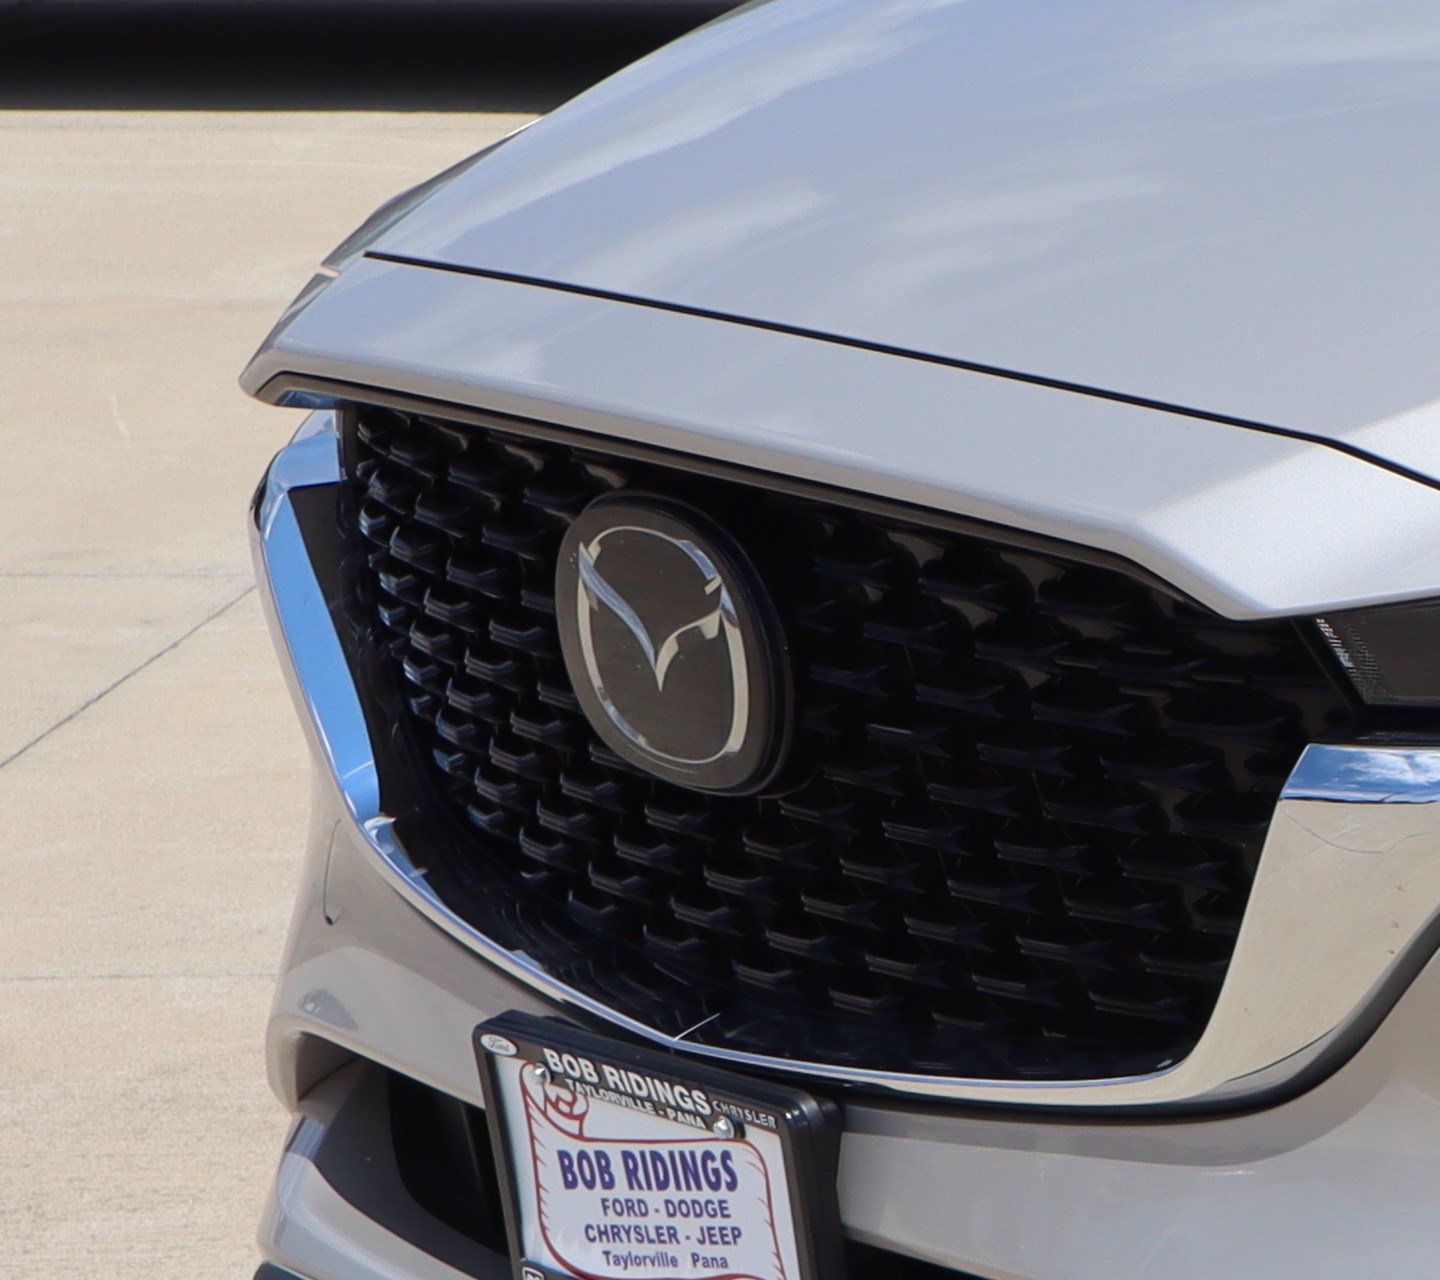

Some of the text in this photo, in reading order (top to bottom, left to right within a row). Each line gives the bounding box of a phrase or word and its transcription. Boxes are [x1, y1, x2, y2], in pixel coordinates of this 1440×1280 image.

[542, 1047, 713, 1116] BOB RIDINGS
[565, 1078, 655, 1114] TAYLORVILLE
[667, 1109, 708, 1130] PANA
[711, 1099, 777, 1129] CHRYSLER
[556, 1149, 739, 1193] BOB RIDINGS
[600, 1197, 650, 1218] FORD
[664, 1198, 732, 1219] DODGE
[584, 1223, 681, 1245] CHRYSLER
[697, 1225, 743, 1246] JEEP
[602, 1249, 730, 1271] Taylorville Pana
